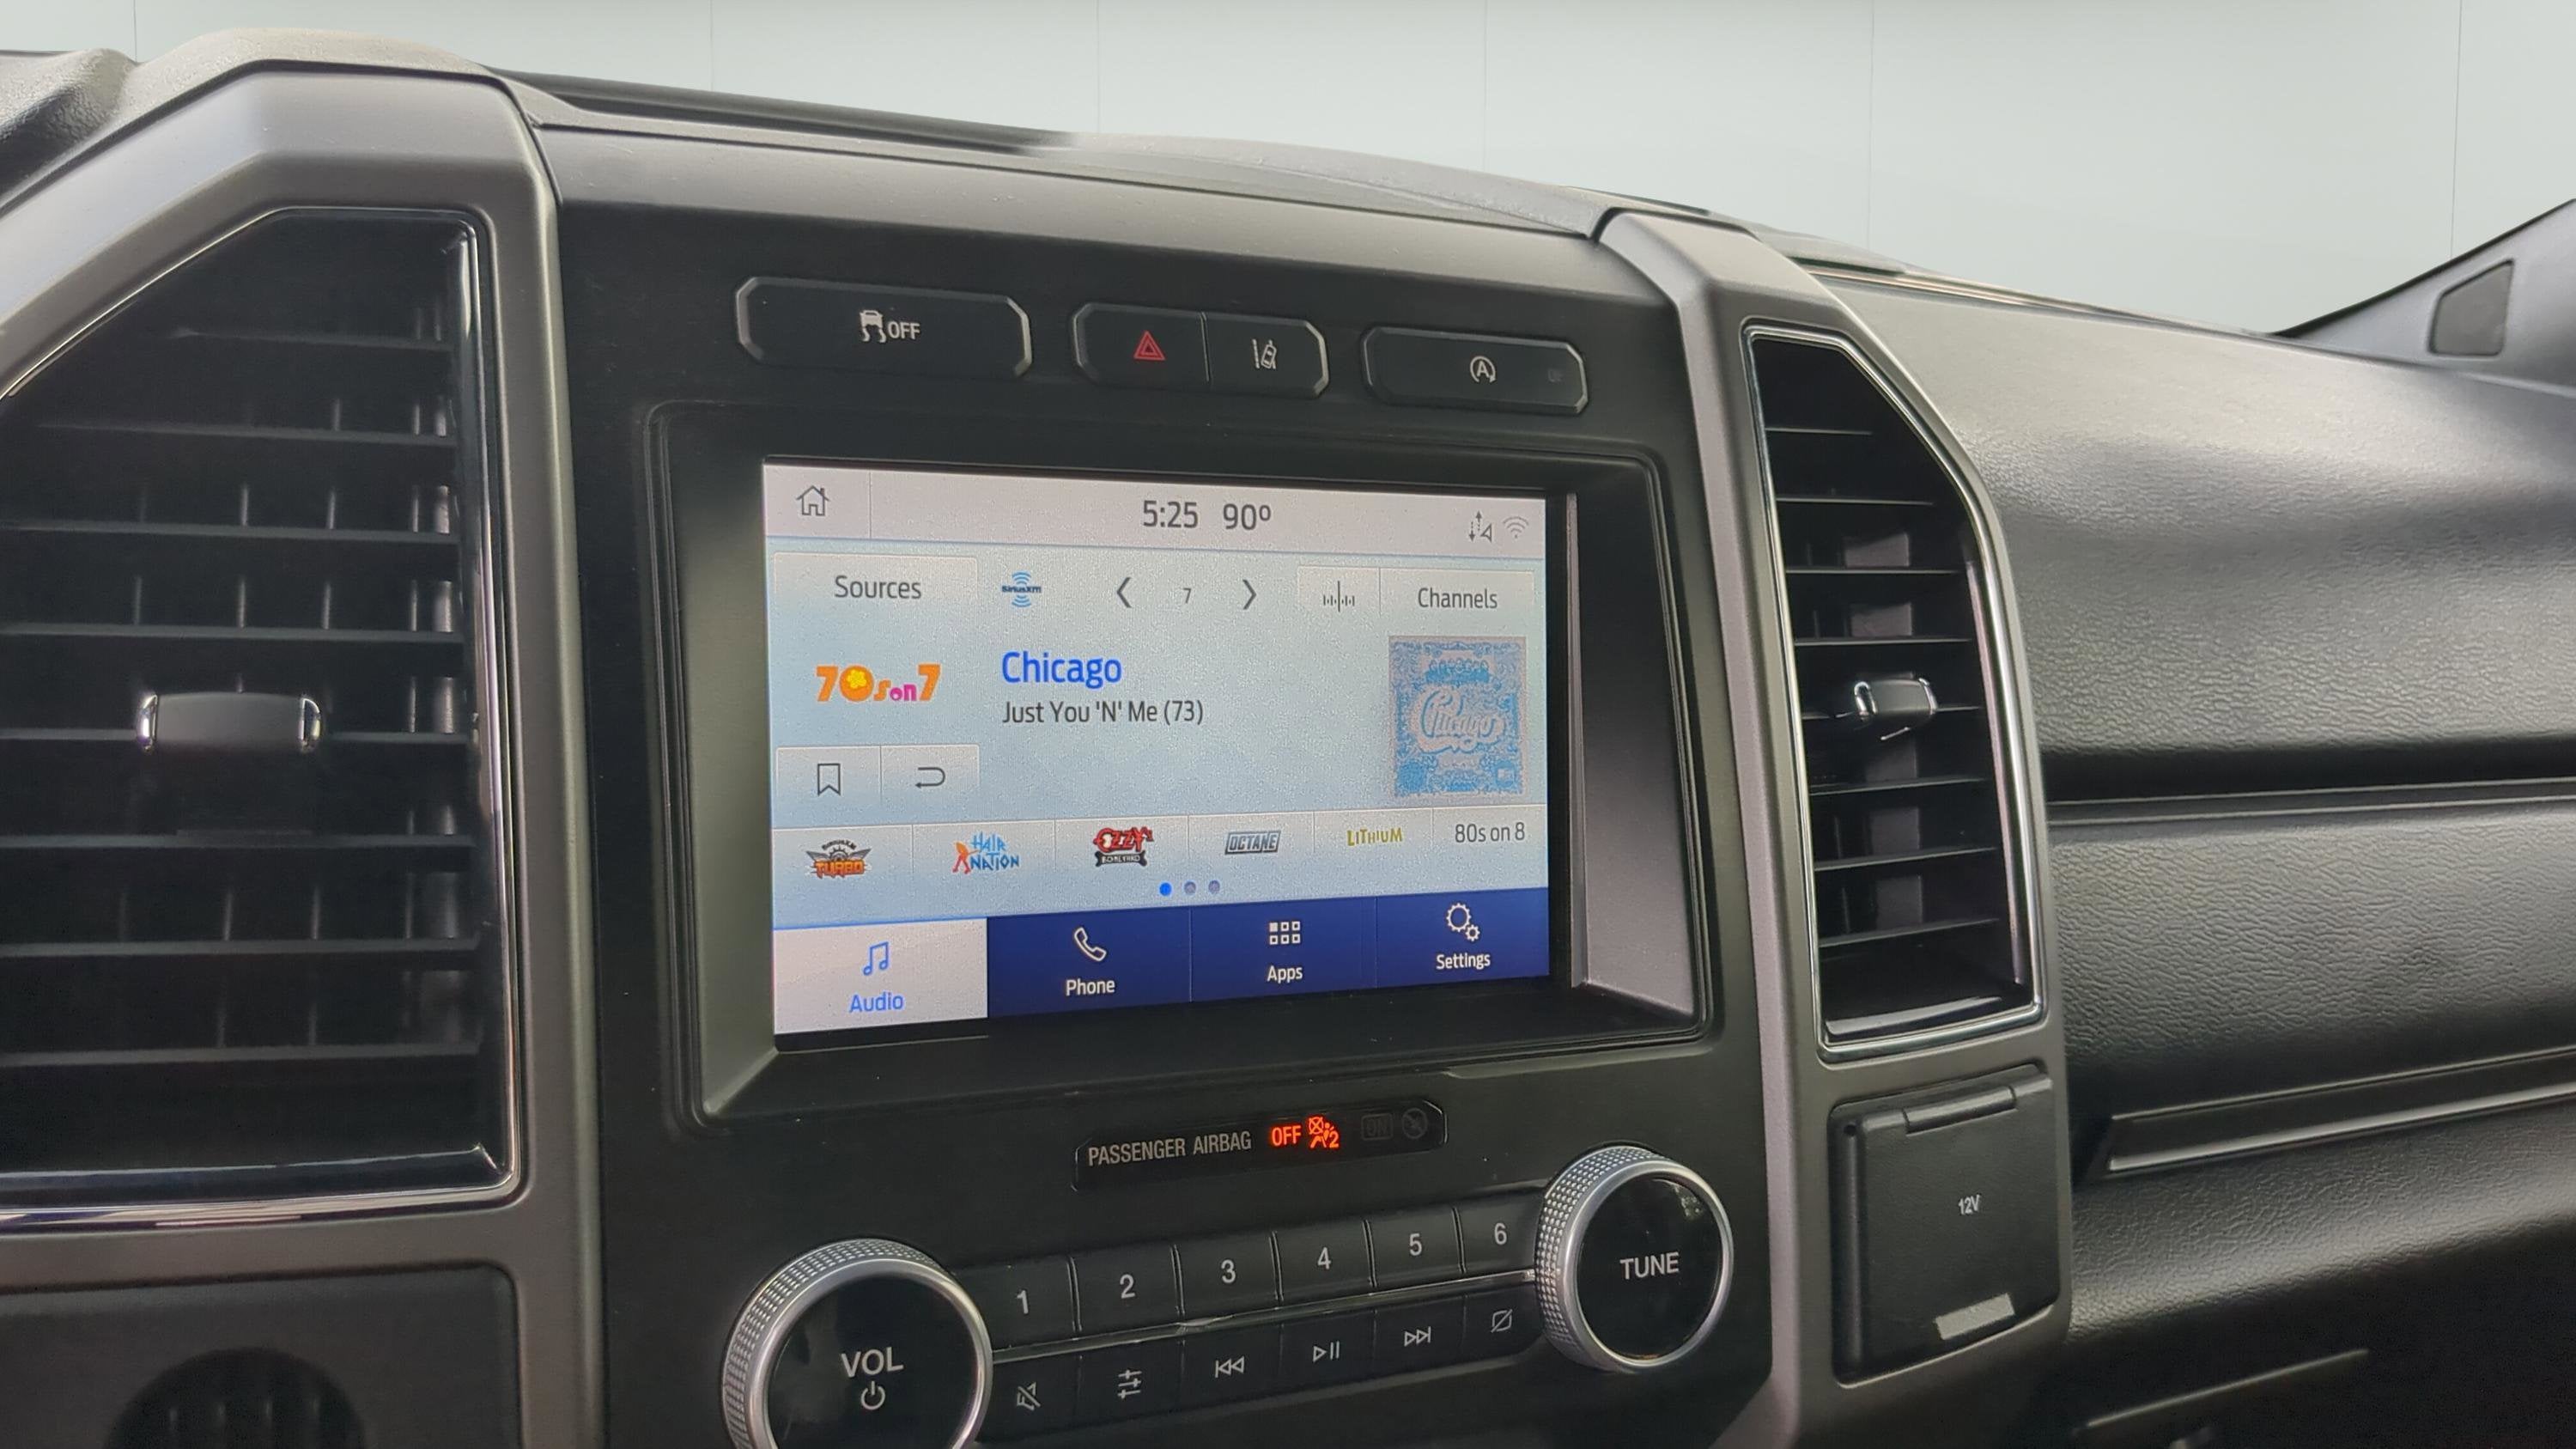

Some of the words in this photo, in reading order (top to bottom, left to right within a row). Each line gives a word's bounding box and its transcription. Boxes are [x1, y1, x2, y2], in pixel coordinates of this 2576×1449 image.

[888, 321, 920, 340] OFF
[1142, 500, 1199, 528] 5:25
[834, 575, 921, 599] Sources
[1183, 588, 1192, 605] 7
[1417, 588, 1498, 609] Channels
[1002, 651, 1122, 690] Chicago
[1002, 701, 1044, 723] Just
[1049, 701, 1090, 722] You
[1097, 700, 1122, 722] 'N'
[1128, 702, 1157, 722] Me
[1163, 700, 1203, 726] (73)
[971, 831, 1005, 852] HAIR
[1229, 833, 1278, 851] OCTANE
[1346, 827, 1402, 846] LITHIUM
[1455, 823, 1486, 843] 80s
[1491, 826, 1510, 842] on
[1515, 822, 1526, 841] 8
[815, 860, 864, 877] TURBO
[970, 854, 1019, 871] NATION
[1436, 951, 1491, 971] Settings
[1267, 965, 1303, 983] Apps
[1066, 978, 1116, 997] Phone
[849, 991, 904, 1013] Audio
[1272, 1125, 1302, 1147] OFF
[1088, 1137, 1186, 1166] PASSENGER
[1193, 1131, 1252, 1155] AIRBAG
[1958, 1194, 1981, 1215] 12V
[1409, 1233, 1422, 1256] 5
[1494, 1223, 1507, 1245] 6
[1317, 1247, 1331, 1269] 4
[1619, 1251, 1680, 1280] TUNE
[1221, 1260, 1236, 1283] 3
[1119, 1275, 1135, 1299] 2
[1017, 1290, 1029, 1314] 1
[841, 1347, 904, 1377] VOL
